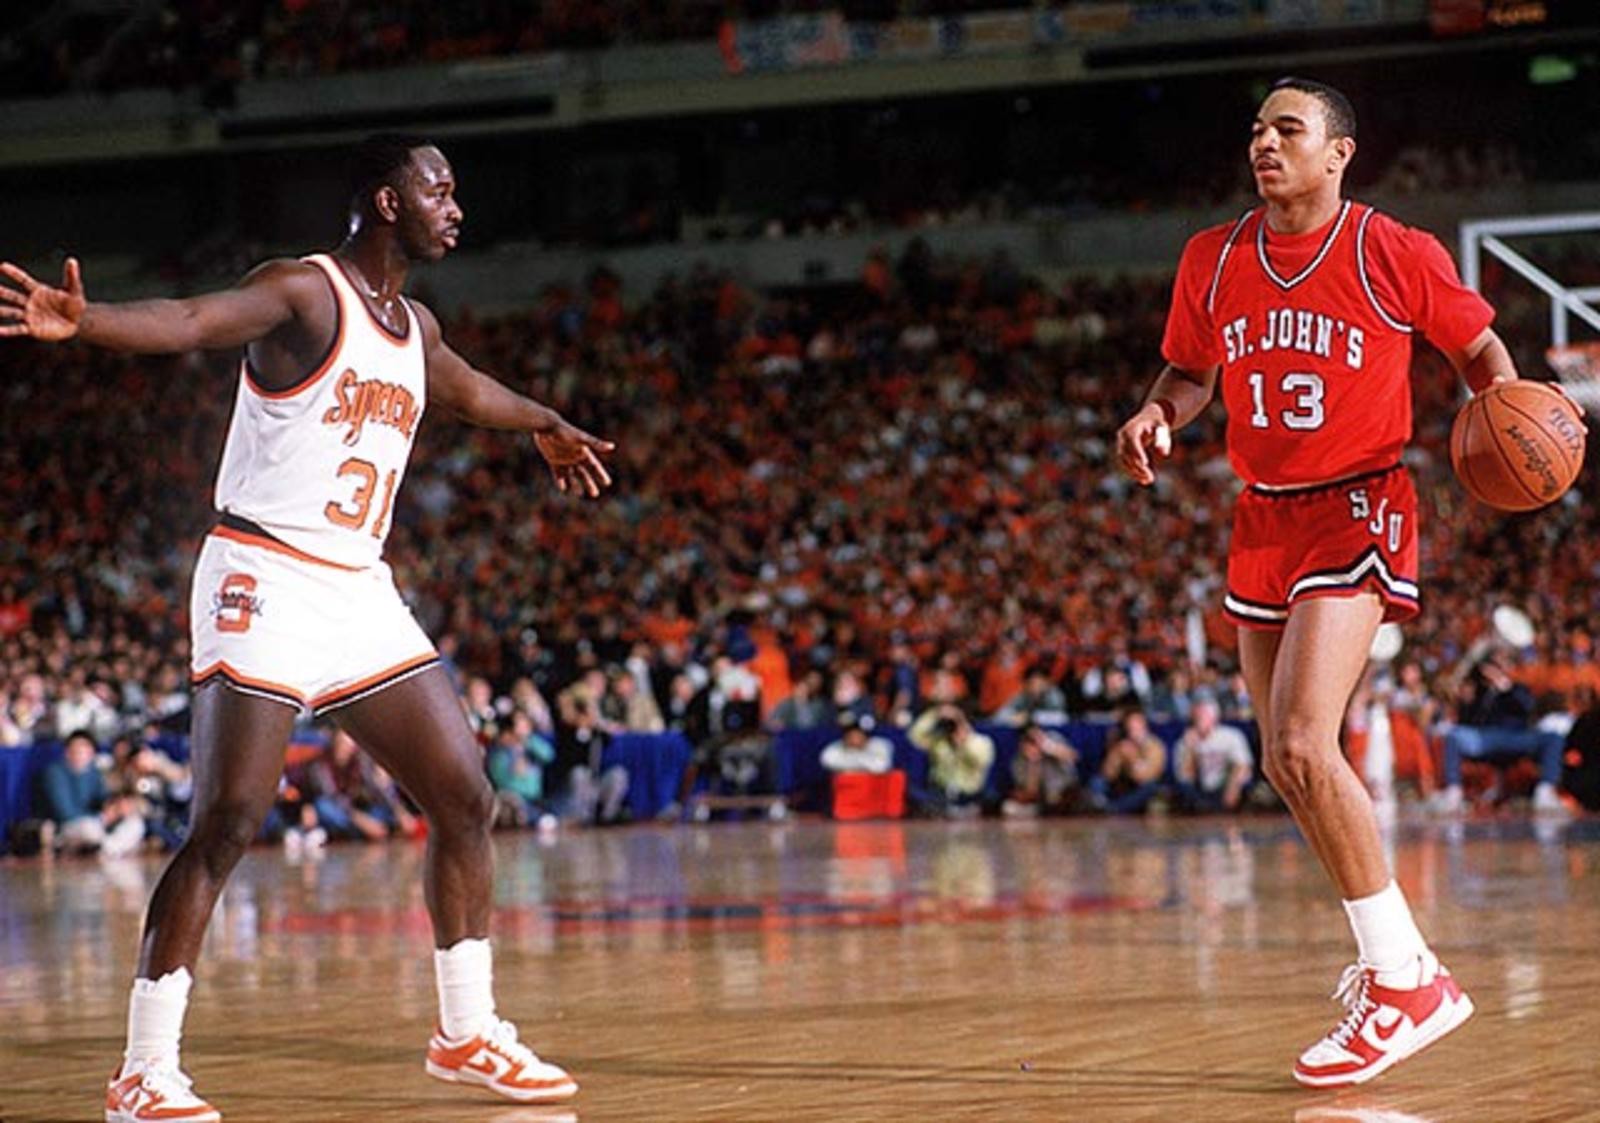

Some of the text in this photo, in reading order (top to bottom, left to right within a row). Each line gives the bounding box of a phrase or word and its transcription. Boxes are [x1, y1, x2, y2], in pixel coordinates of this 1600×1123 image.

[1222, 307, 1365, 370] ST. JOHN'S
[1248, 372, 1325, 430] 13
[323, 456, 397, 539] 31
[1349, 488, 1403, 553] SJU
